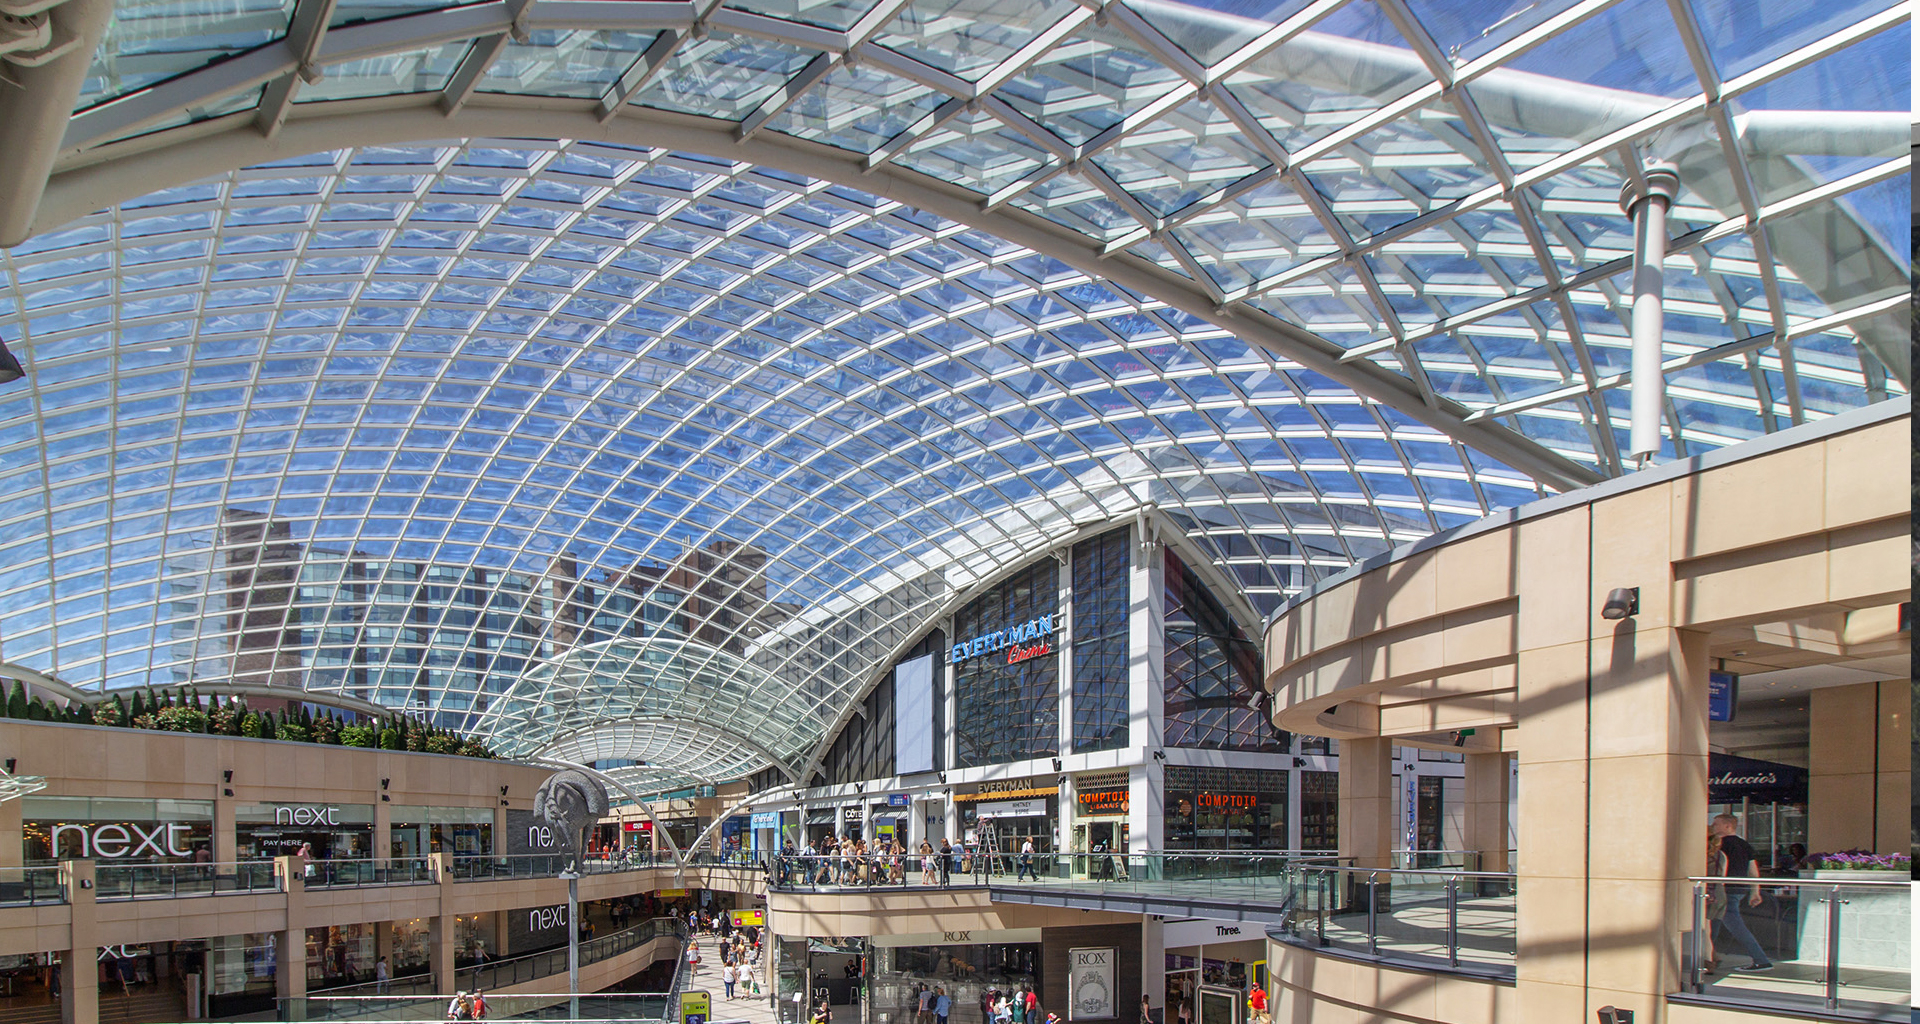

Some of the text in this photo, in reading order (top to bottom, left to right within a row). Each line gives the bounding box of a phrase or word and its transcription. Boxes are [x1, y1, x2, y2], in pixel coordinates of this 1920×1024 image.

[952, 613, 1053, 663] EVERYMAN
[1007, 643, 1051, 664] Cinema
[978, 779, 1032, 794] EVERYMAN
[1078, 791, 1129, 804] COMPTOIR
[1197, 794, 1257, 807] COMPTOIR
[275, 806, 340, 826] next
[51, 822, 193, 858] next
[263, 839, 303, 847] PAY HERE
[529, 825, 555, 848] ne
[529, 904, 567, 932] next
[943, 930, 972, 942] ROX
[1215, 925, 1242, 937] Three.
[1077, 952, 1106, 965] ROX
